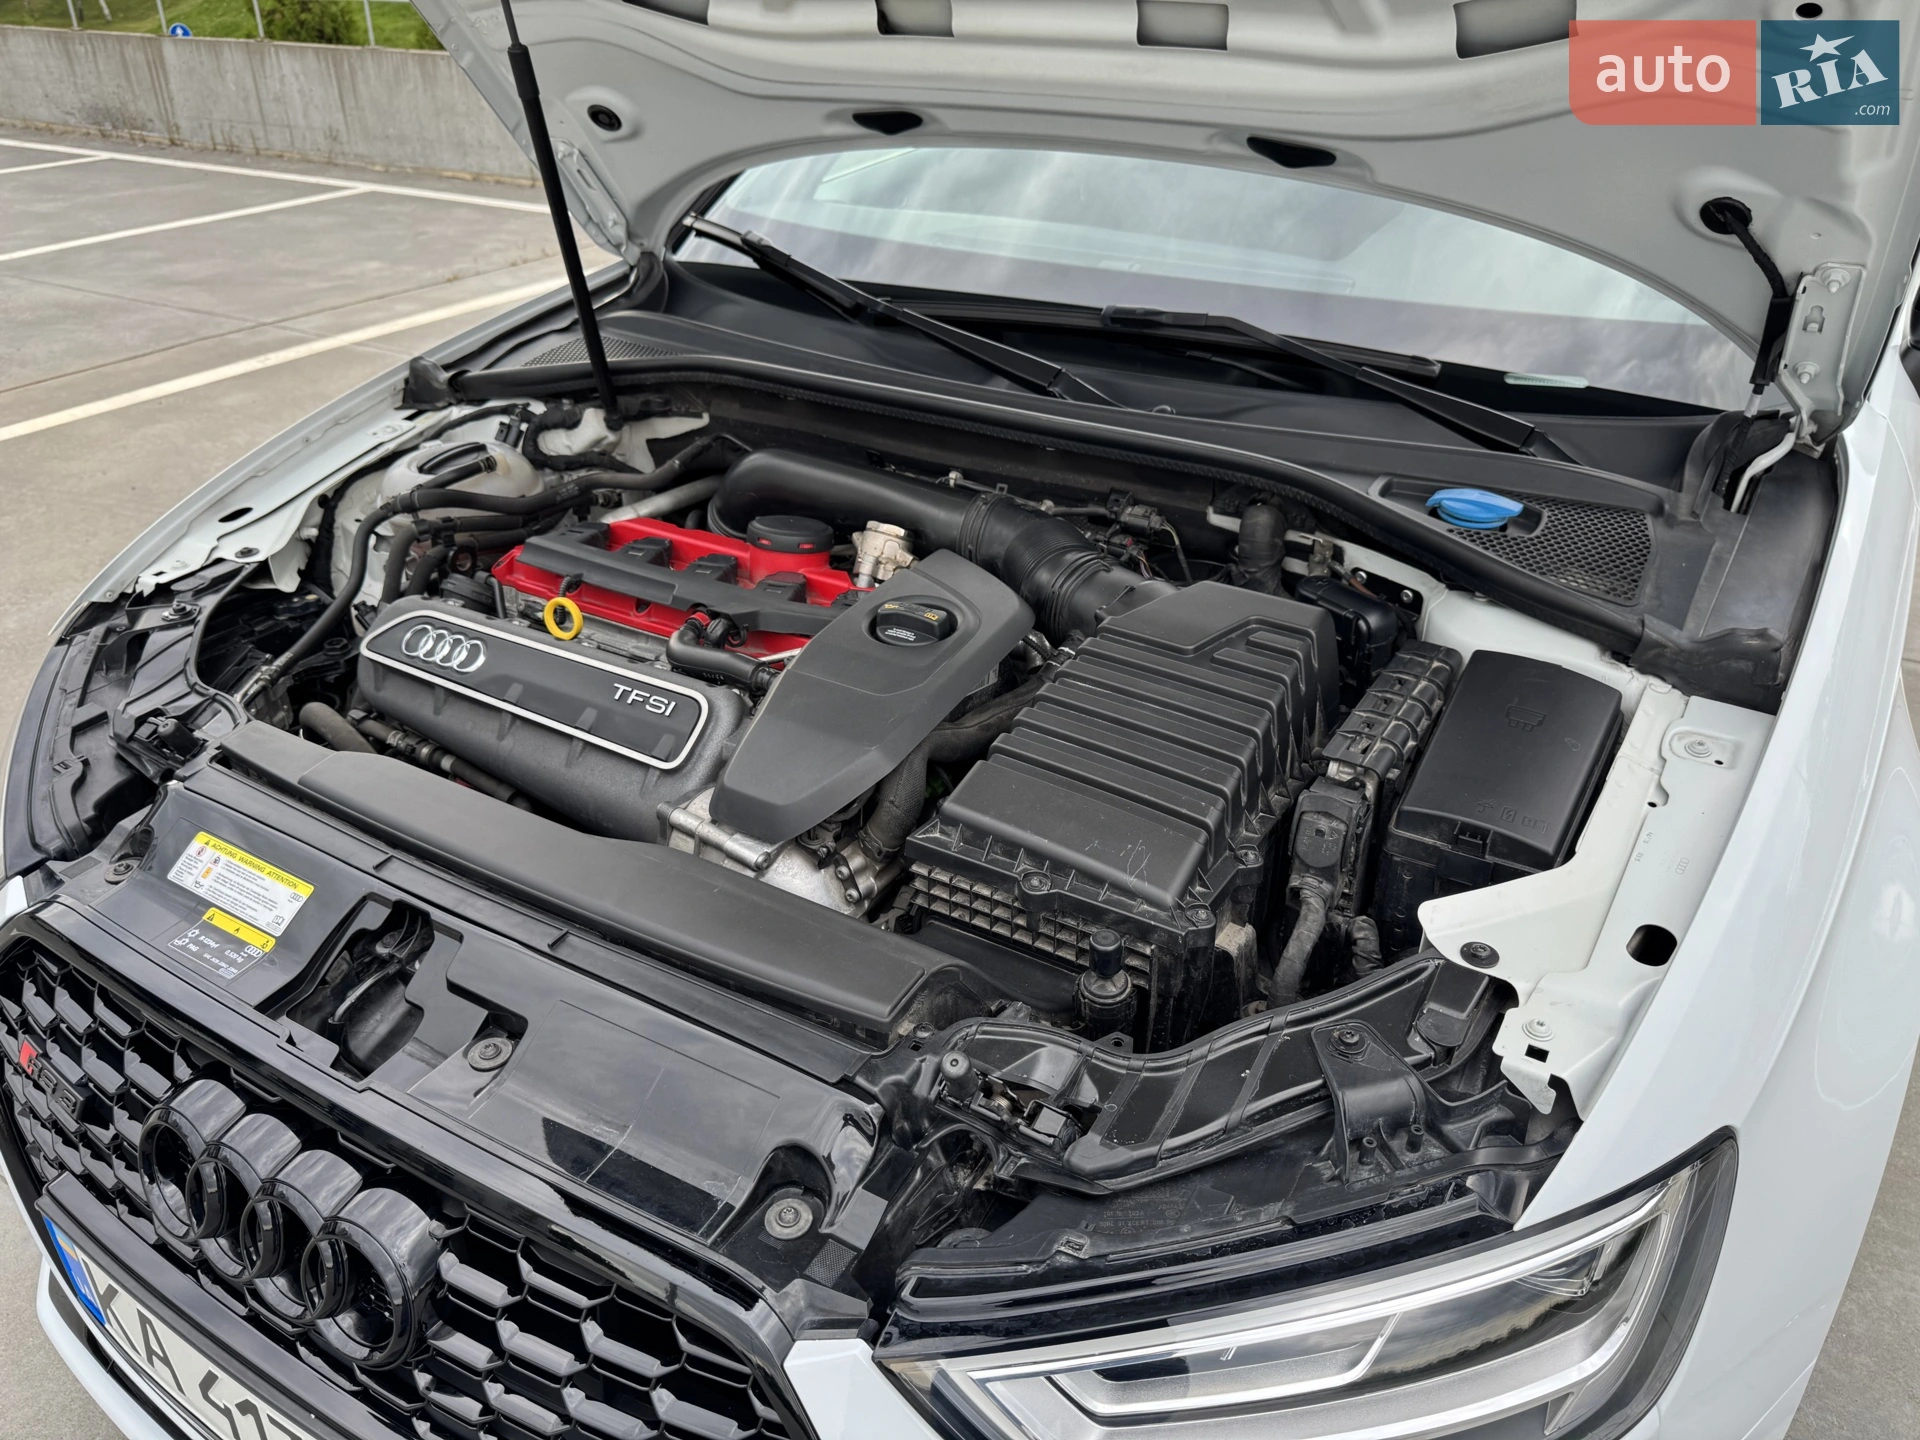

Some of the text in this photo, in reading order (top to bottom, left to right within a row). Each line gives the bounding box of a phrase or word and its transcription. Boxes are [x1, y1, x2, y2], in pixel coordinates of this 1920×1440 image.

[613, 682, 677, 717] TFSI
[211, 843, 299, 890] ACHTUNG WARNING ATTENTION
